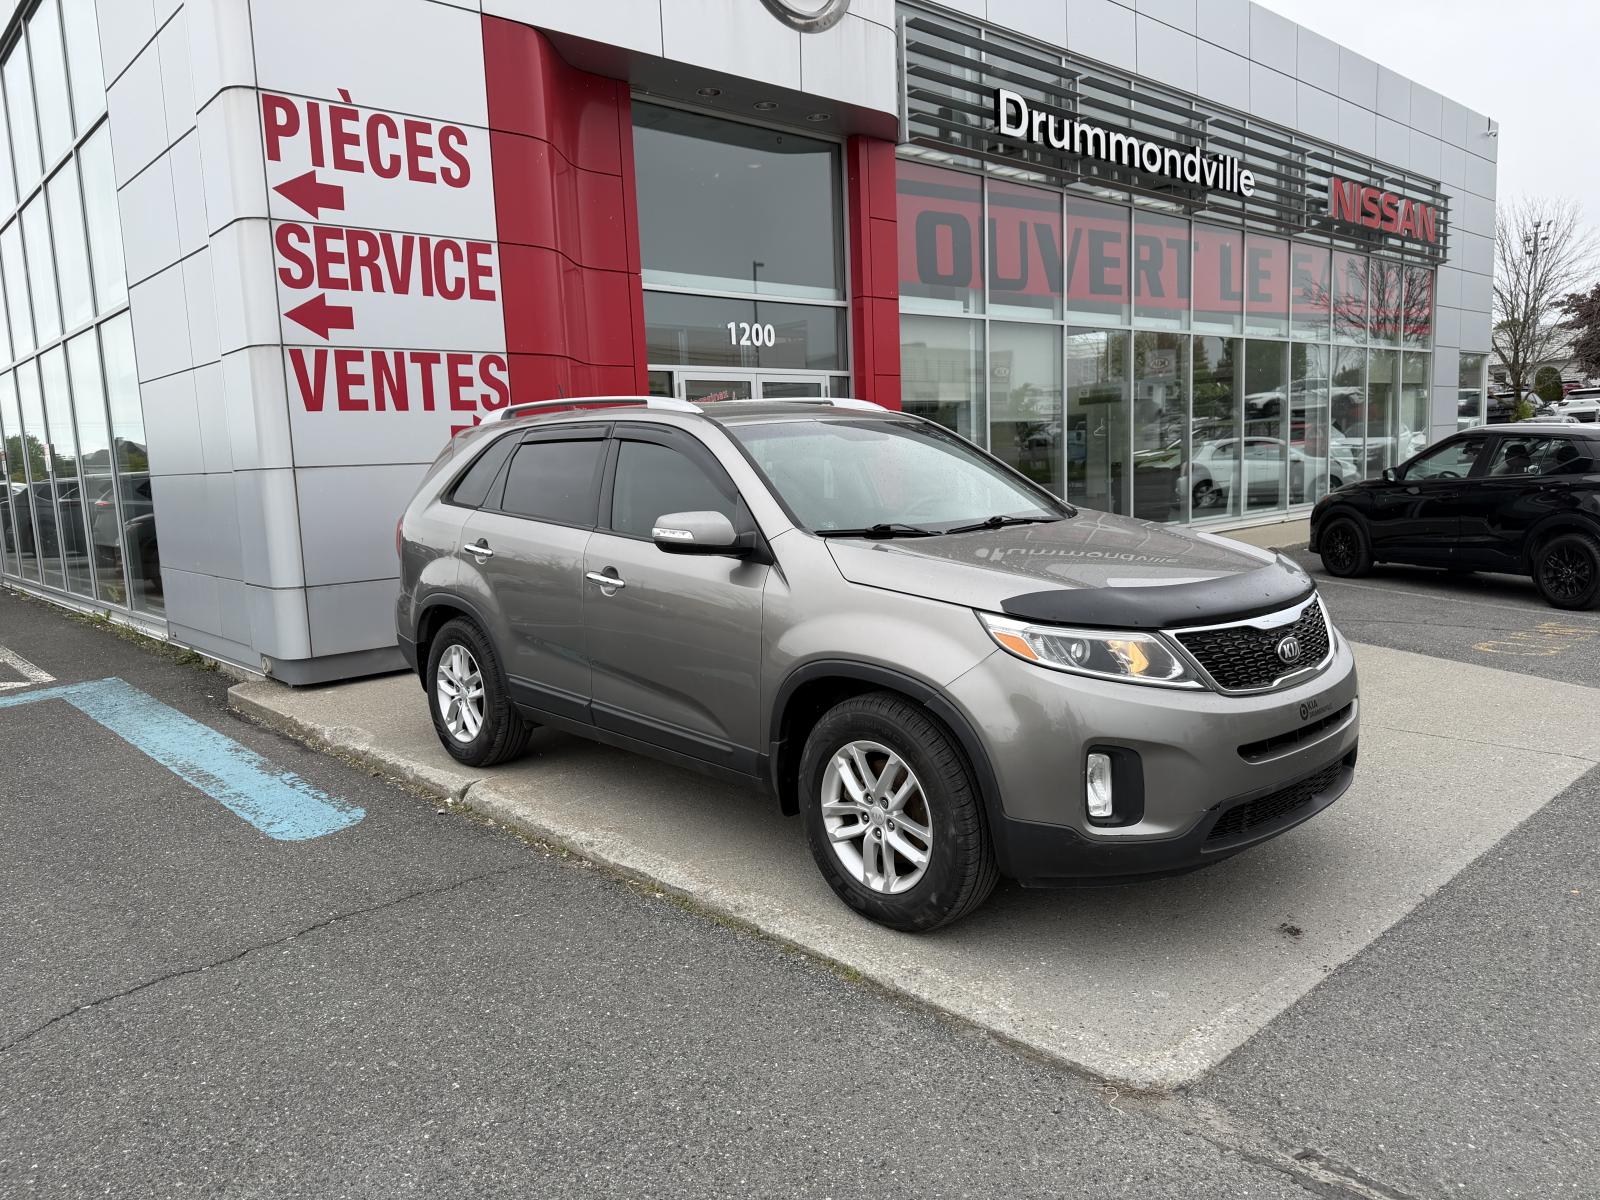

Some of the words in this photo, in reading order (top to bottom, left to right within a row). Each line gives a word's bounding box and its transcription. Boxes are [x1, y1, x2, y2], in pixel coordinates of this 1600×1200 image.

[261, 88, 471, 188] PIÈCES
[994, 88, 1256, 197] Drummondville
[1327, 176, 1437, 243] NISSAN
[275, 223, 497, 301] SERVICE
[915, 210, 1199, 299] OUVERT
[1219, 242, 1273, 302] LE
[727, 321, 776, 347] 1200
[288, 348, 510, 412] VENTES
[1282, 641, 1300, 659] KIA
[1306, 699, 1319, 711] KIA
